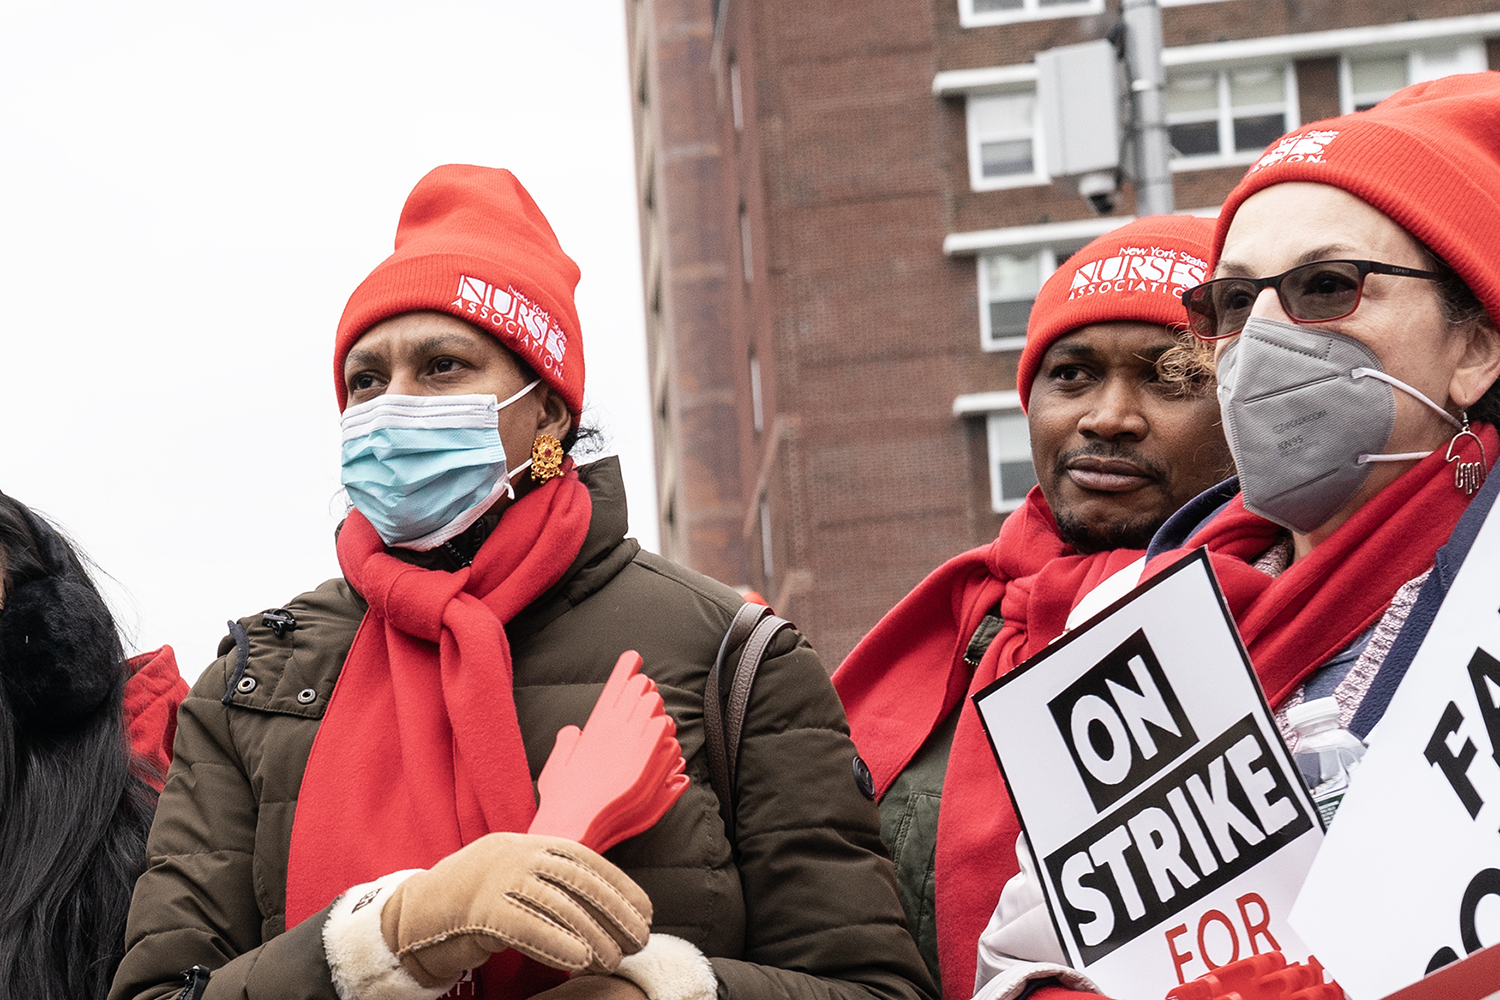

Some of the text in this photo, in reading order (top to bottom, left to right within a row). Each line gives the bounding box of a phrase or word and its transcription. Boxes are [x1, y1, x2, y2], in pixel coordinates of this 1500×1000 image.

[1070, 255, 1206, 291] NURSES
[1119, 246, 1208, 269] New York State
[457, 274, 566, 367] NURSES
[1069, 653, 1183, 785] ON
[1060, 733, 1299, 947] STRIKE
[1165, 892, 1282, 985] FOR
